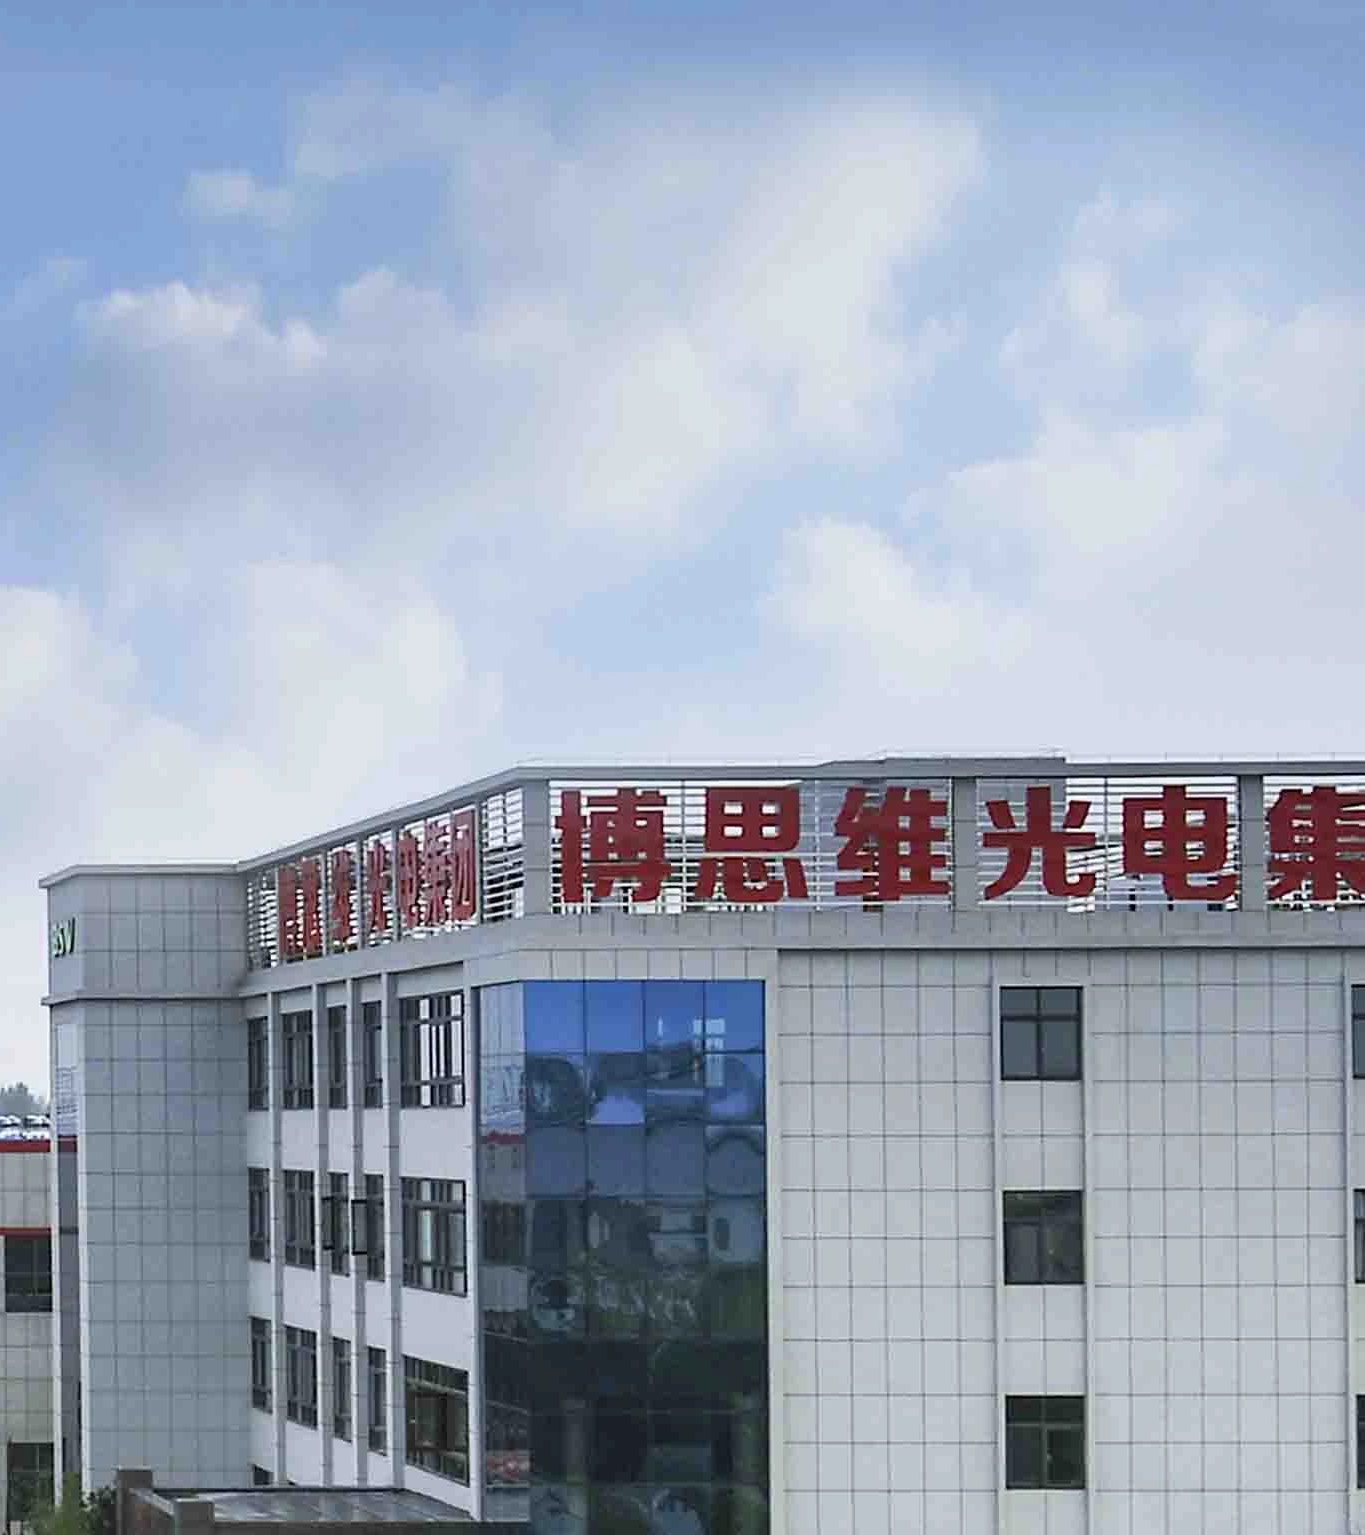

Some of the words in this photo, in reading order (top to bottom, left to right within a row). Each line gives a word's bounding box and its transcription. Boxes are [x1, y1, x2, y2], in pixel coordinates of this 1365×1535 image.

[555, 785, 1365, 904] 博思维光电集
